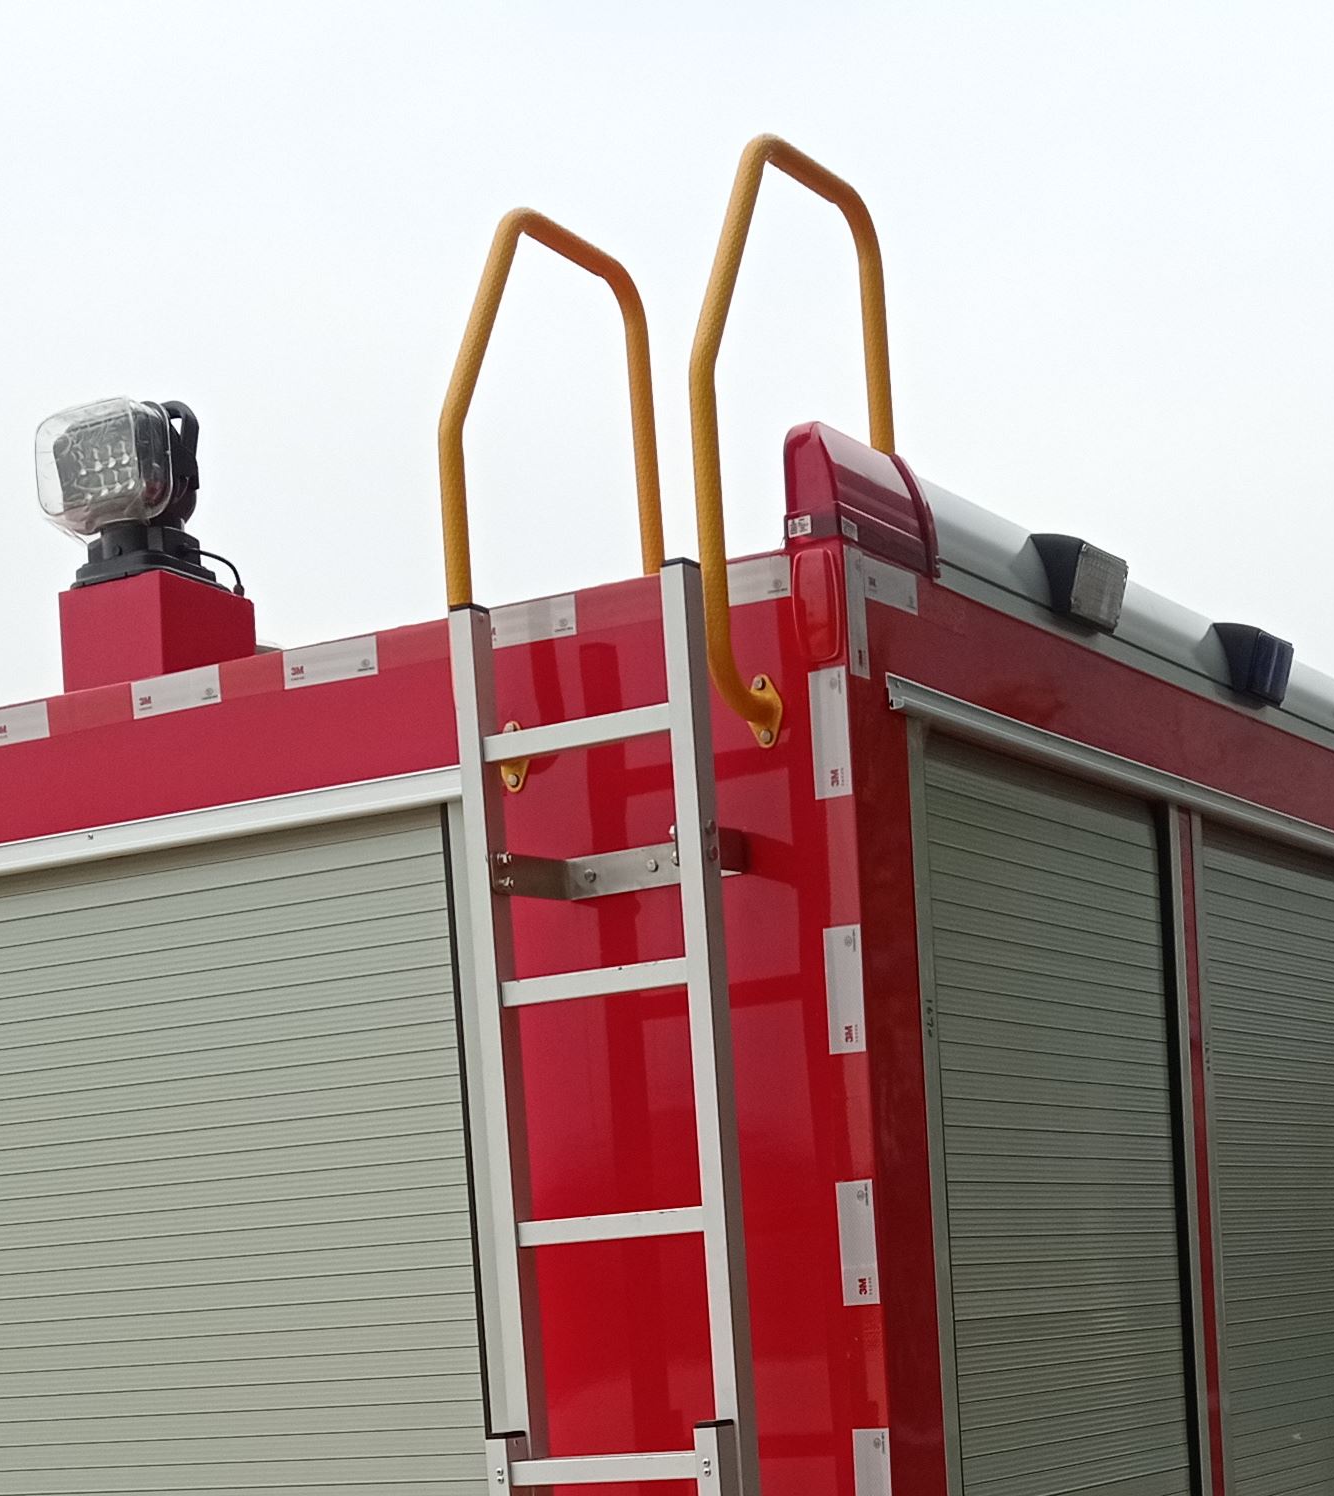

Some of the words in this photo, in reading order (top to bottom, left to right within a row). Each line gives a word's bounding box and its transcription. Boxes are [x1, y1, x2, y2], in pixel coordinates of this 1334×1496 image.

[830, 768, 839, 787] 3M
[844, 1025, 853, 1043] 3M
[858, 1278, 867, 1295] 3M
